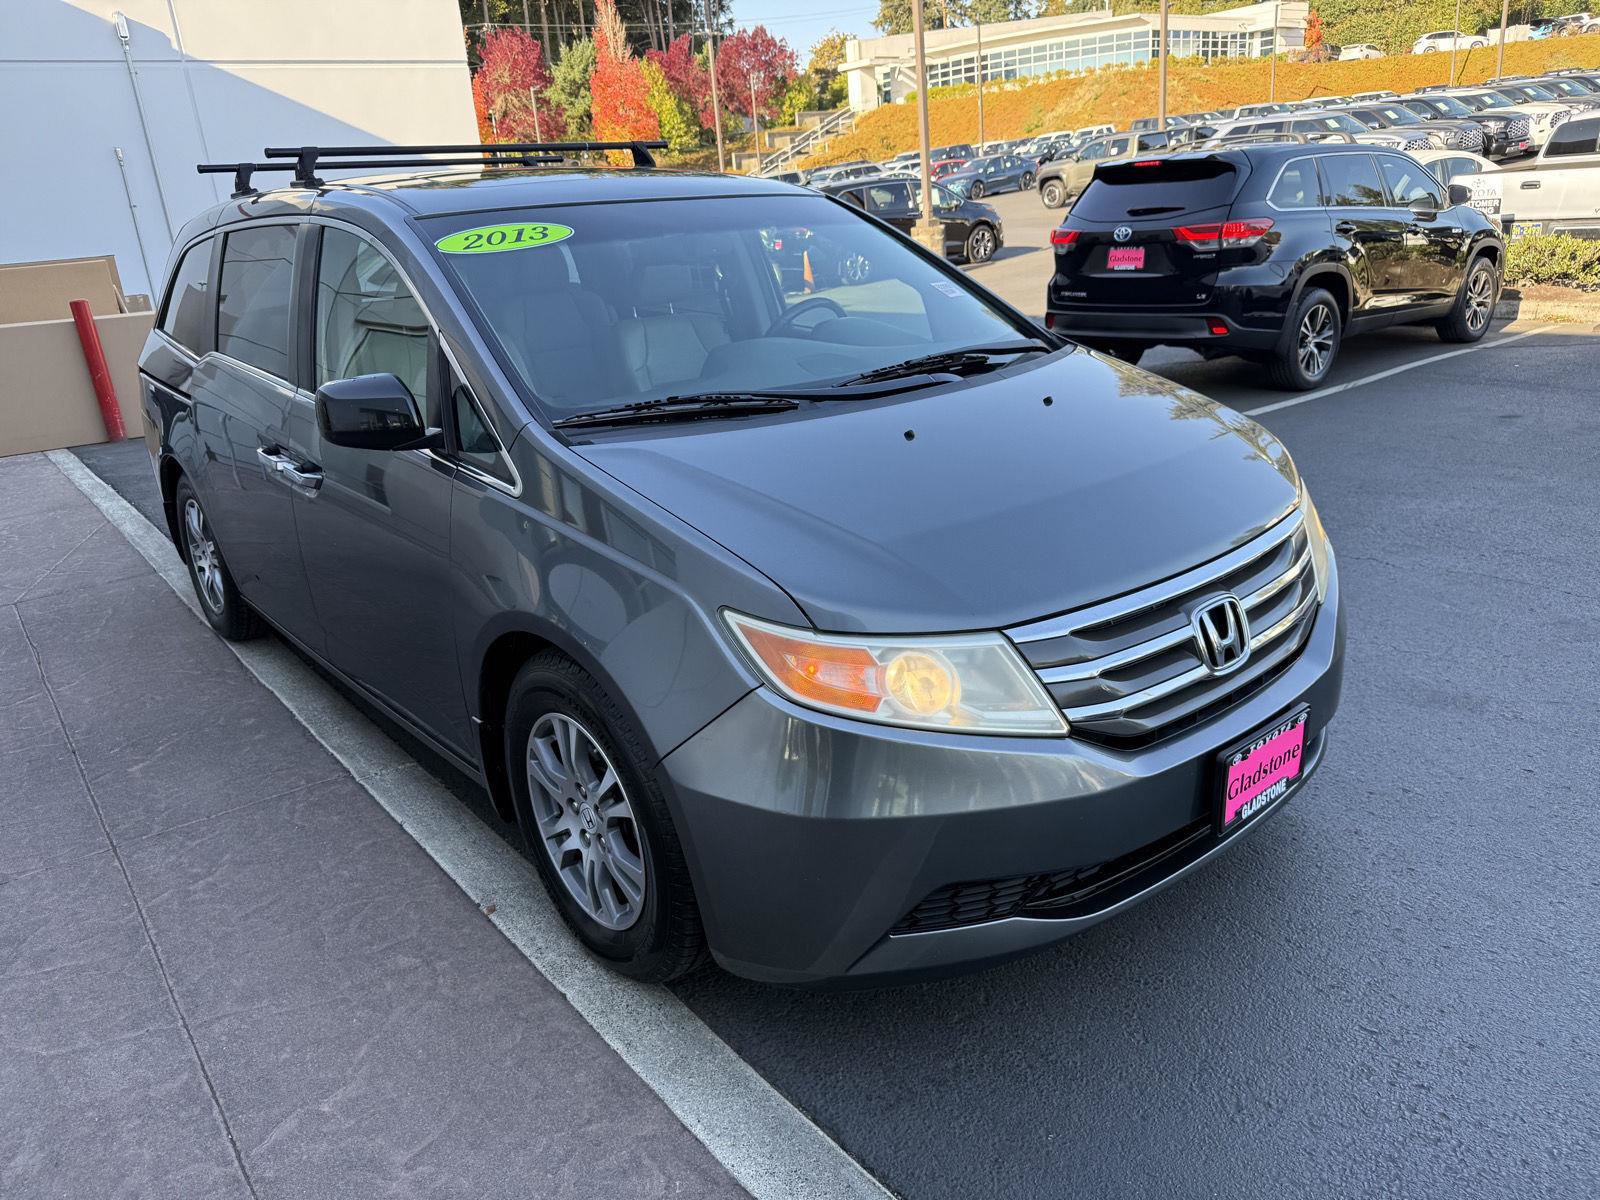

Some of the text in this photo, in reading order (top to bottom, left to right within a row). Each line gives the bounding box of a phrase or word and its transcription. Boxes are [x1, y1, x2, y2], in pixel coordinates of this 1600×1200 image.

[462, 226, 549, 250] 2013
[1109, 254, 1143, 263] Gladstone
[1247, 722, 1292, 757] TOYOTA
[1228, 743, 1300, 801] Gladstone
[1241, 777, 1287, 819] GLADSTONE
